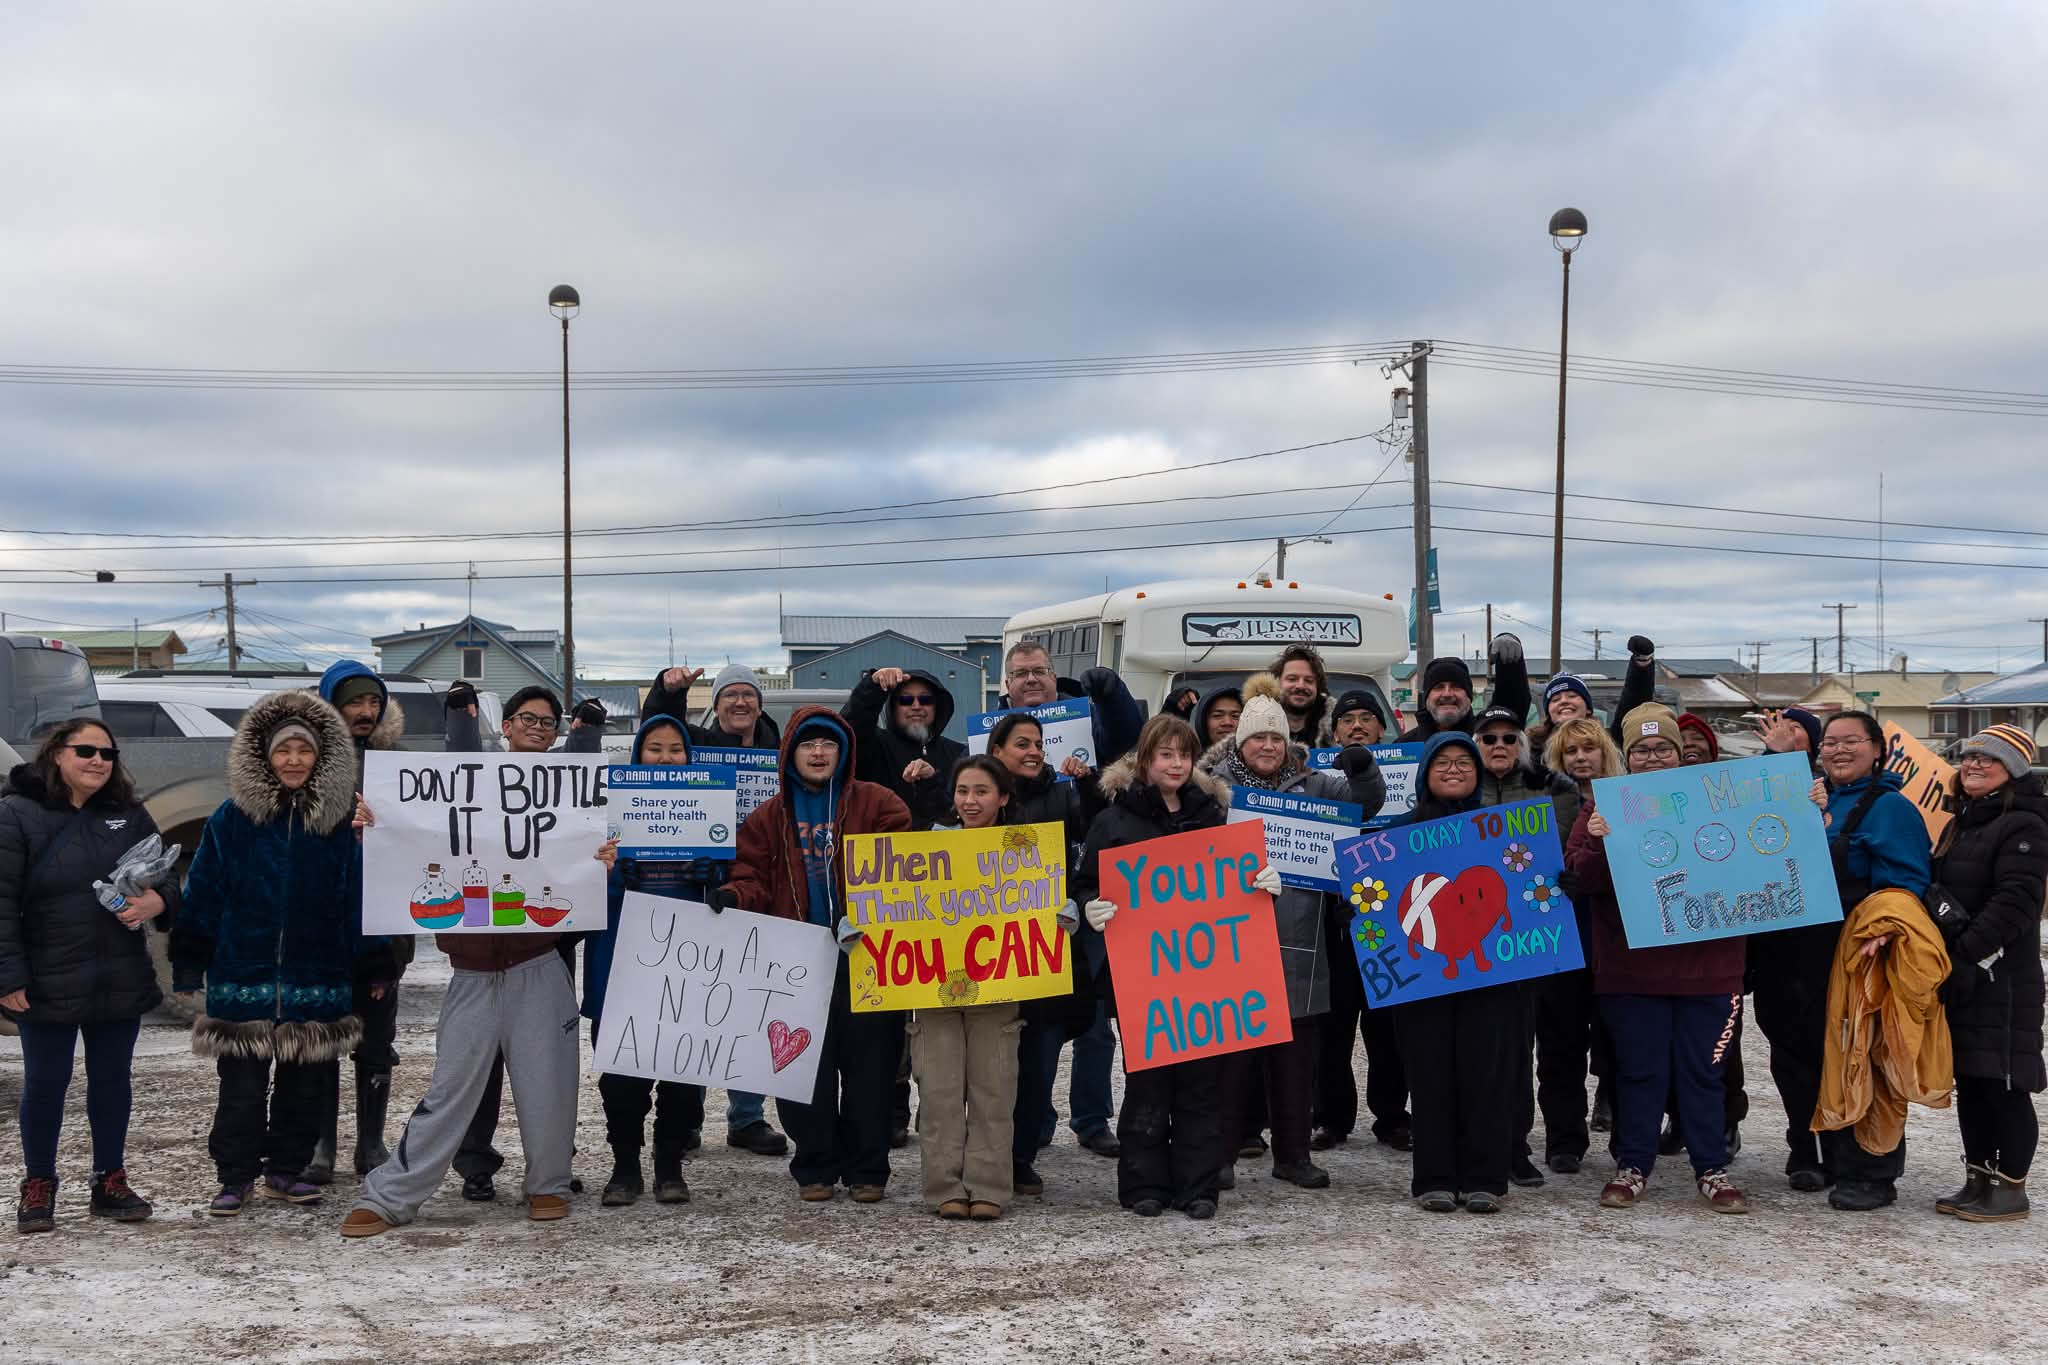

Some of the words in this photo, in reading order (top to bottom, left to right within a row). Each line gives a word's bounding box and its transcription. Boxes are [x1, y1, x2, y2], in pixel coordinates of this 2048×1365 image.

[1031, 705, 1067, 719] CAMPUS
[1045, 735, 1063, 745] not
[1373, 749, 1402, 759] AMPUS
[725, 753, 737, 763] ON
[739, 754, 776, 765] CAMPUS
[1886, 733, 1920, 787] Stay
[1918, 769, 1944, 813] in
[399, 763, 484, 804] DON'T
[498, 763, 609, 815] BOTTLE
[653, 771, 667, 782] ON
[669, 771, 710, 782] CAMPUS
[763, 775, 780, 785] the
[1386, 771, 1408, 780] way
[631, 796, 667, 808] Share
[671, 798, 699, 811] your
[754, 788, 775, 797] and
[1620, 786, 1690, 825] Keep
[623, 810, 665, 821] mental
[668, 810, 707, 821] health
[1285, 799, 1298, 811] ON
[1299, 802, 1339, 816] CAMPUS
[448, 806, 483, 857] IT
[504, 811, 557, 860] UP
[647, 823, 683, 836] story.
[1264, 834, 1292, 848] ealth
[1294, 839, 1307, 851] to
[1309, 840, 1329, 854] the
[1294, 826, 1335, 842] mental
[1343, 832, 1397, 875] ITS
[1408, 819, 1464, 853] OKAY
[1471, 812, 1503, 840] TO
[1504, 802, 1553, 838] NOT
[845, 836, 952, 886] When
[976, 845, 1042, 895] you
[1291, 852, 1319, 865] level
[1115, 845, 1260, 910] You're
[847, 885, 937, 926] Think
[939, 886, 998, 926] you
[1000, 863, 1065, 914] can't
[1652, 856, 1806, 937] Forward
[739, 926, 808, 988] Are
[964, 917, 1065, 982] CAN
[1151, 913, 1251, 977] NOT
[1360, 943, 1423, 1001] BE
[1496, 922, 1562, 962] OKAY
[658, 974, 796, 1033] NOT
[1145, 989, 1267, 1061] Alone
